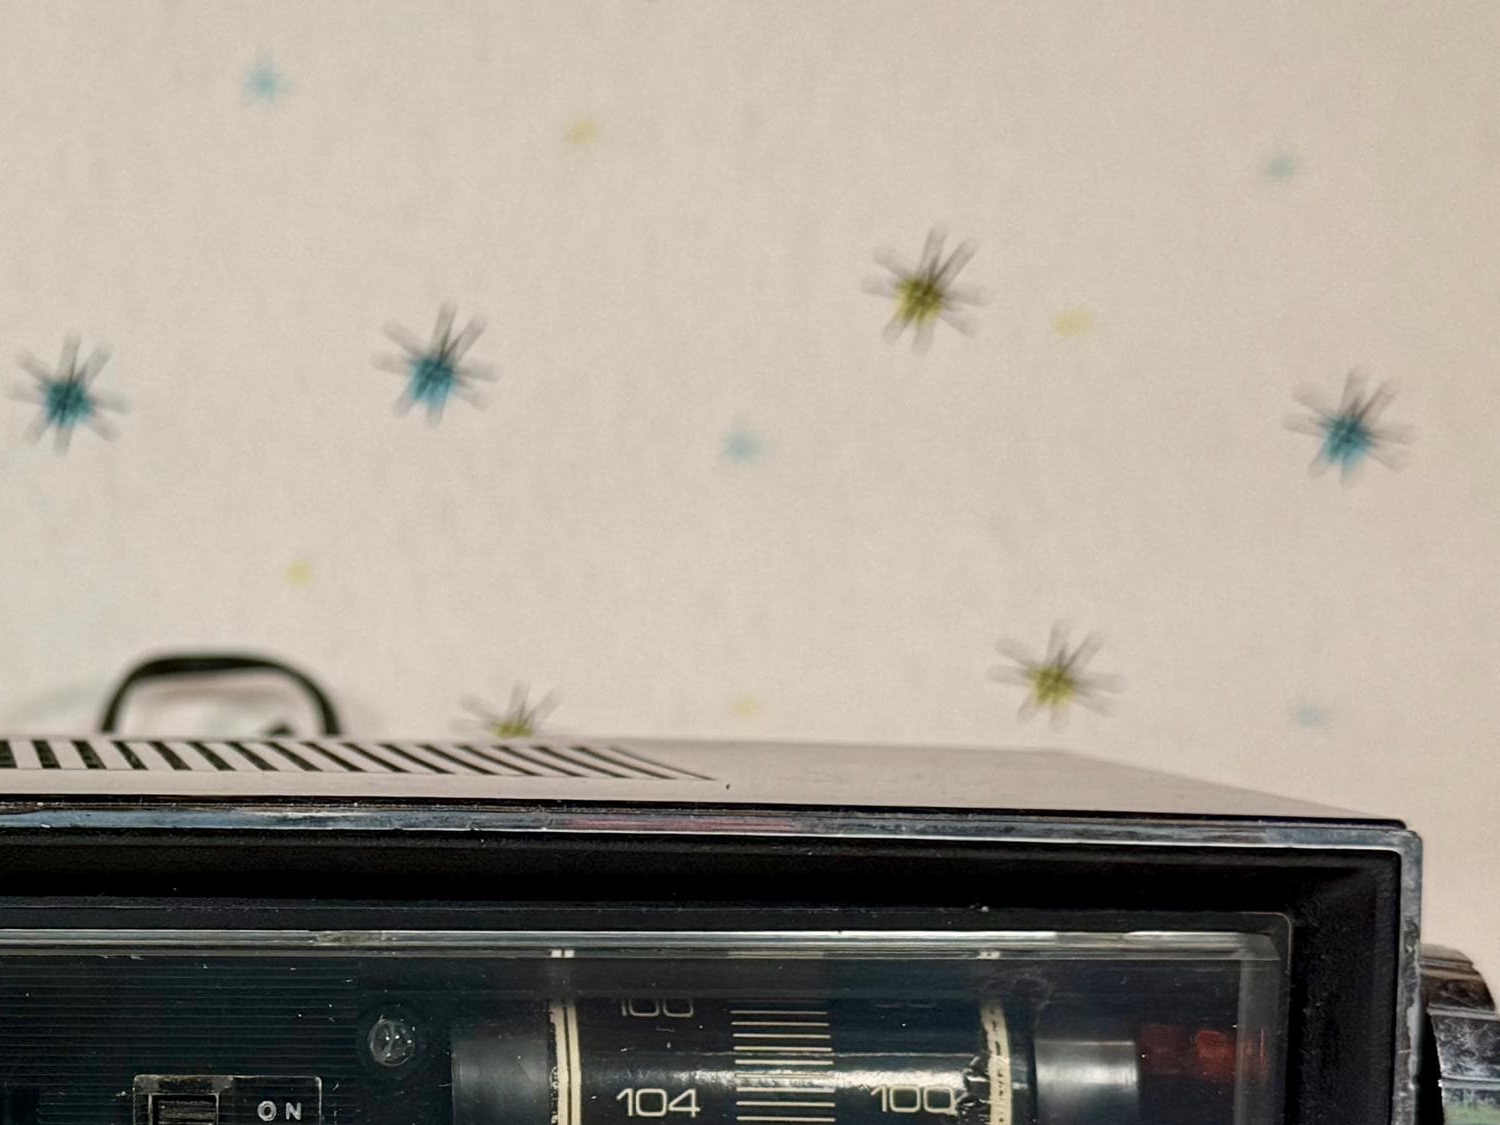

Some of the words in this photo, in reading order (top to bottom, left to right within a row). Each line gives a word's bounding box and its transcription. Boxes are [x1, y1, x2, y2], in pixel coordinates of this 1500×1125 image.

[257, 1101, 302, 1122] ON
[616, 1088, 700, 1118] 104
[870, 1084, 956, 1114] 100
